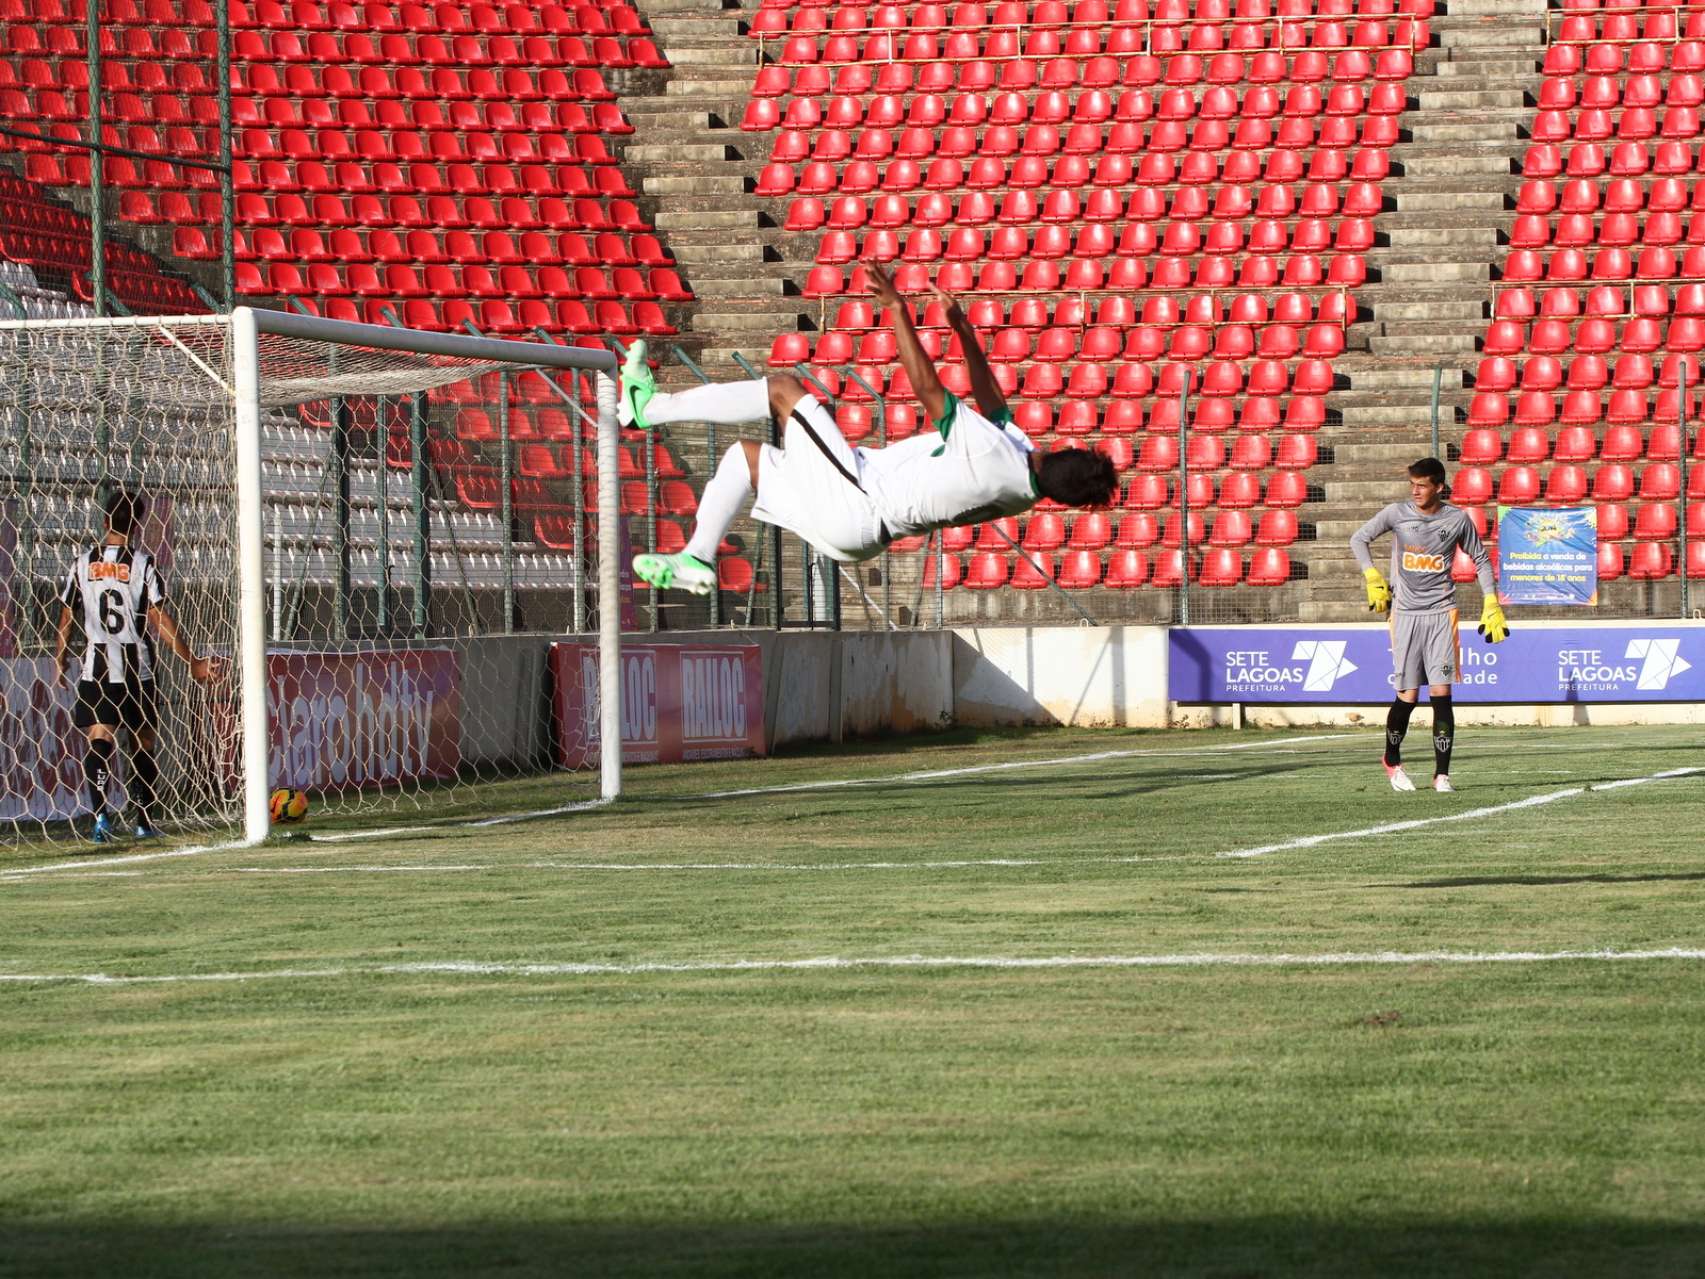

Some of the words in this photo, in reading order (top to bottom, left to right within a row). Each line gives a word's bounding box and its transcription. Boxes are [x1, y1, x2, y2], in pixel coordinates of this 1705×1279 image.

[1402, 552, 1444, 572] BMG
[1574, 564, 1593, 572] para
[99, 589, 125, 635] 6
[1225, 651, 1269, 667] SETE
[1558, 650, 1601, 665] SETE
[1225, 667, 1304, 684] LAGOAS
[1558, 666, 1637, 682] LAGOAS
[1225, 684, 1286, 692] PREFEITURA
[1558, 683, 1619, 691] PREFEITURA
[582, 655, 656, 741] RLOC
[681, 656, 746, 738] RAILOC
